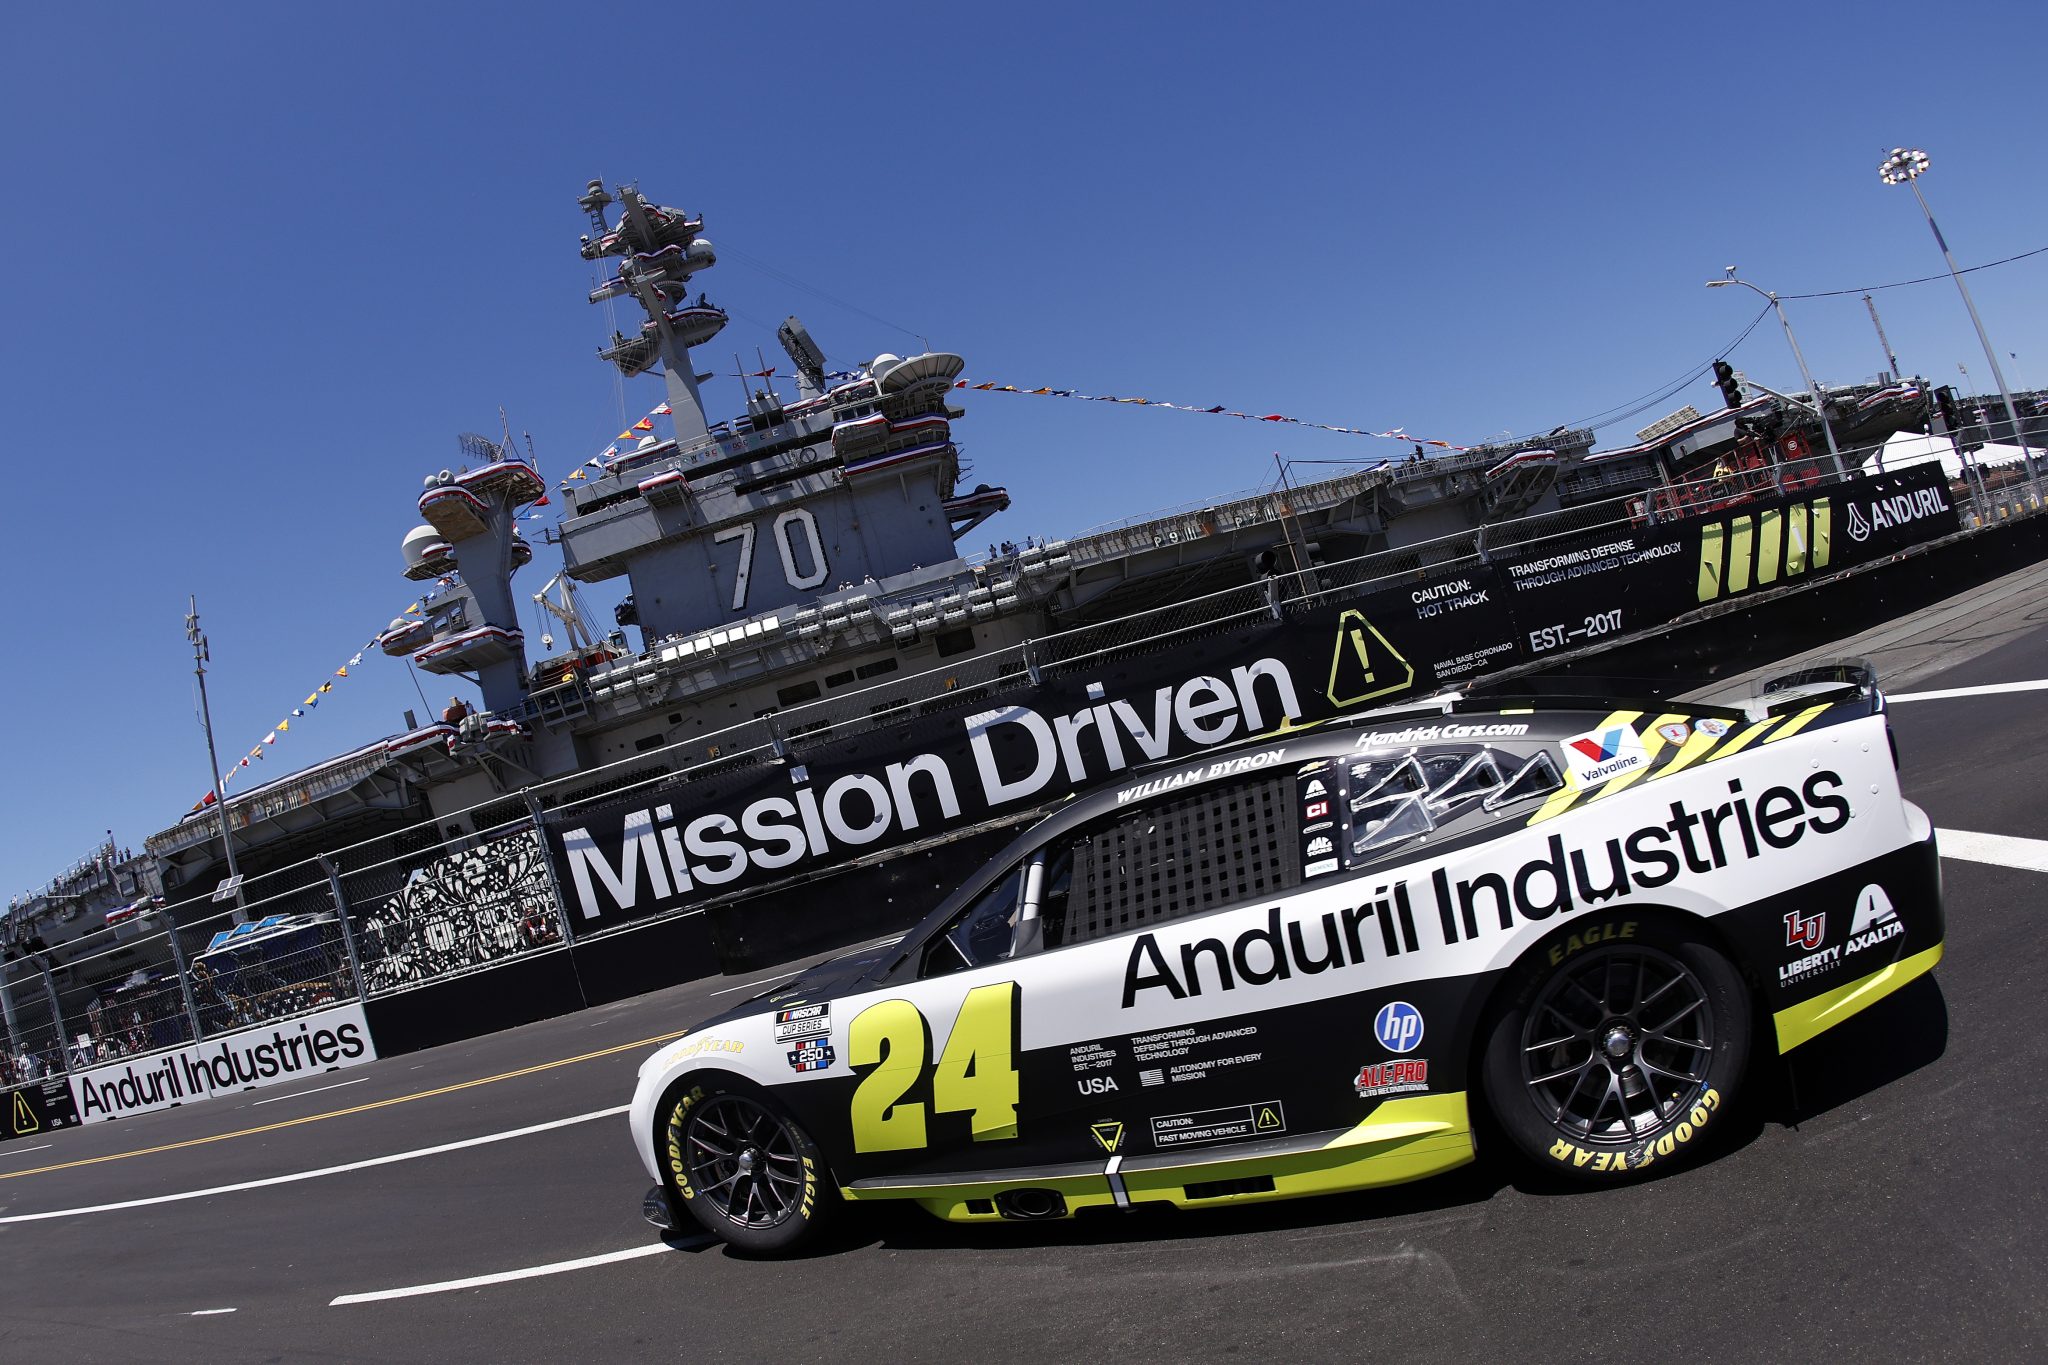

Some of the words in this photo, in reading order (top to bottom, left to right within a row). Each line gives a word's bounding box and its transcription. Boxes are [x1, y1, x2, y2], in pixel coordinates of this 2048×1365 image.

[1871, 487, 1949, 531] ANDURIL
[714, 508, 831, 611] 70
[1508, 550, 1591, 578] TRANSFORMING
[1590, 539, 1636, 560] DEFENSE
[1513, 570, 1566, 592] THROUGH
[1567, 557, 1620, 579] ADVANCED
[1620, 542, 1682, 566] TECHNOLOGY
[1412, 579, 1472, 604] CAUTION:
[1417, 602, 1443, 619] HOT
[1445, 590, 1489, 611] TRACK
[1433, 657, 1456, 670] NAVAL
[1455, 652, 1475, 665] BASE
[1474, 642, 1513, 659] CORONADO
[1436, 668, 1451, 679] SAN
[1116, 767, 1204, 804] WILLIAM
[1206, 749, 1286, 779] BYRON
[1581, 755, 1639, 782] Valvoline
[561, 765, 962, 919] Mission
[965, 657, 1303, 806] Driven
[1306, 801, 1328, 818] CI
[1121, 876, 1420, 1008] Anduril
[1432, 770, 1850, 944] Industries
[1783, 910, 1826, 950] LU
[1845, 920, 1904, 956] AXALTA
[1547, 921, 1639, 967] EAGLE
[1779, 945, 1841, 980] LIBERTY
[1780, 961, 1841, 988] UNIVERSITY
[792, 1006, 822, 1020] NASCAR
[782, 1025, 797, 1035] CUP
[797, 1020, 823, 1032] SERIES
[1131, 1028, 1196, 1045] TRANSFORMING
[1133, 1041, 1170, 1053] DEFENSE
[1170, 1034, 1211, 1048] THROUGH
[1212, 1026, 1257, 1041] ADVANCED
[1382, 1003, 1418, 1051] hp
[799, 1047, 824, 1063] 250
[1070, 1043, 1104, 1055] ANDURIL
[1071, 1050, 1117, 1063] INDUSTRIES
[1135, 1047, 1190, 1062] TECHNOLOGY
[82, 1056, 184, 1118] Anduril
[180, 1023, 365, 1094] Industries
[848, 980, 1022, 1154] 24
[1170, 1060, 1216, 1074] AUTONOMY
[1217, 1057, 1235, 1067] FOR
[1235, 1053, 1262, 1064] EVERY
[1171, 1070, 1206, 1083] MISSION
[1357, 1061, 1428, 1090] ALL-PRO
[1078, 1076, 1119, 1095] USA
[1359, 1088, 1378, 1098] AUTO
[1378, 1083, 1429, 1095] RECONDITIONING
[1156, 1117, 1194, 1129] CAUTION:
[1158, 1132, 1179, 1143] FAST
[1179, 1128, 1212, 1141] MOVING
[1212, 1124, 1247, 1137] VEHICLE
[1549, 1088, 1720, 1172] GOODYEAR
[668, 1085, 704, 1200] GOODYEAR
[800, 1156, 817, 1221] EAGLE
